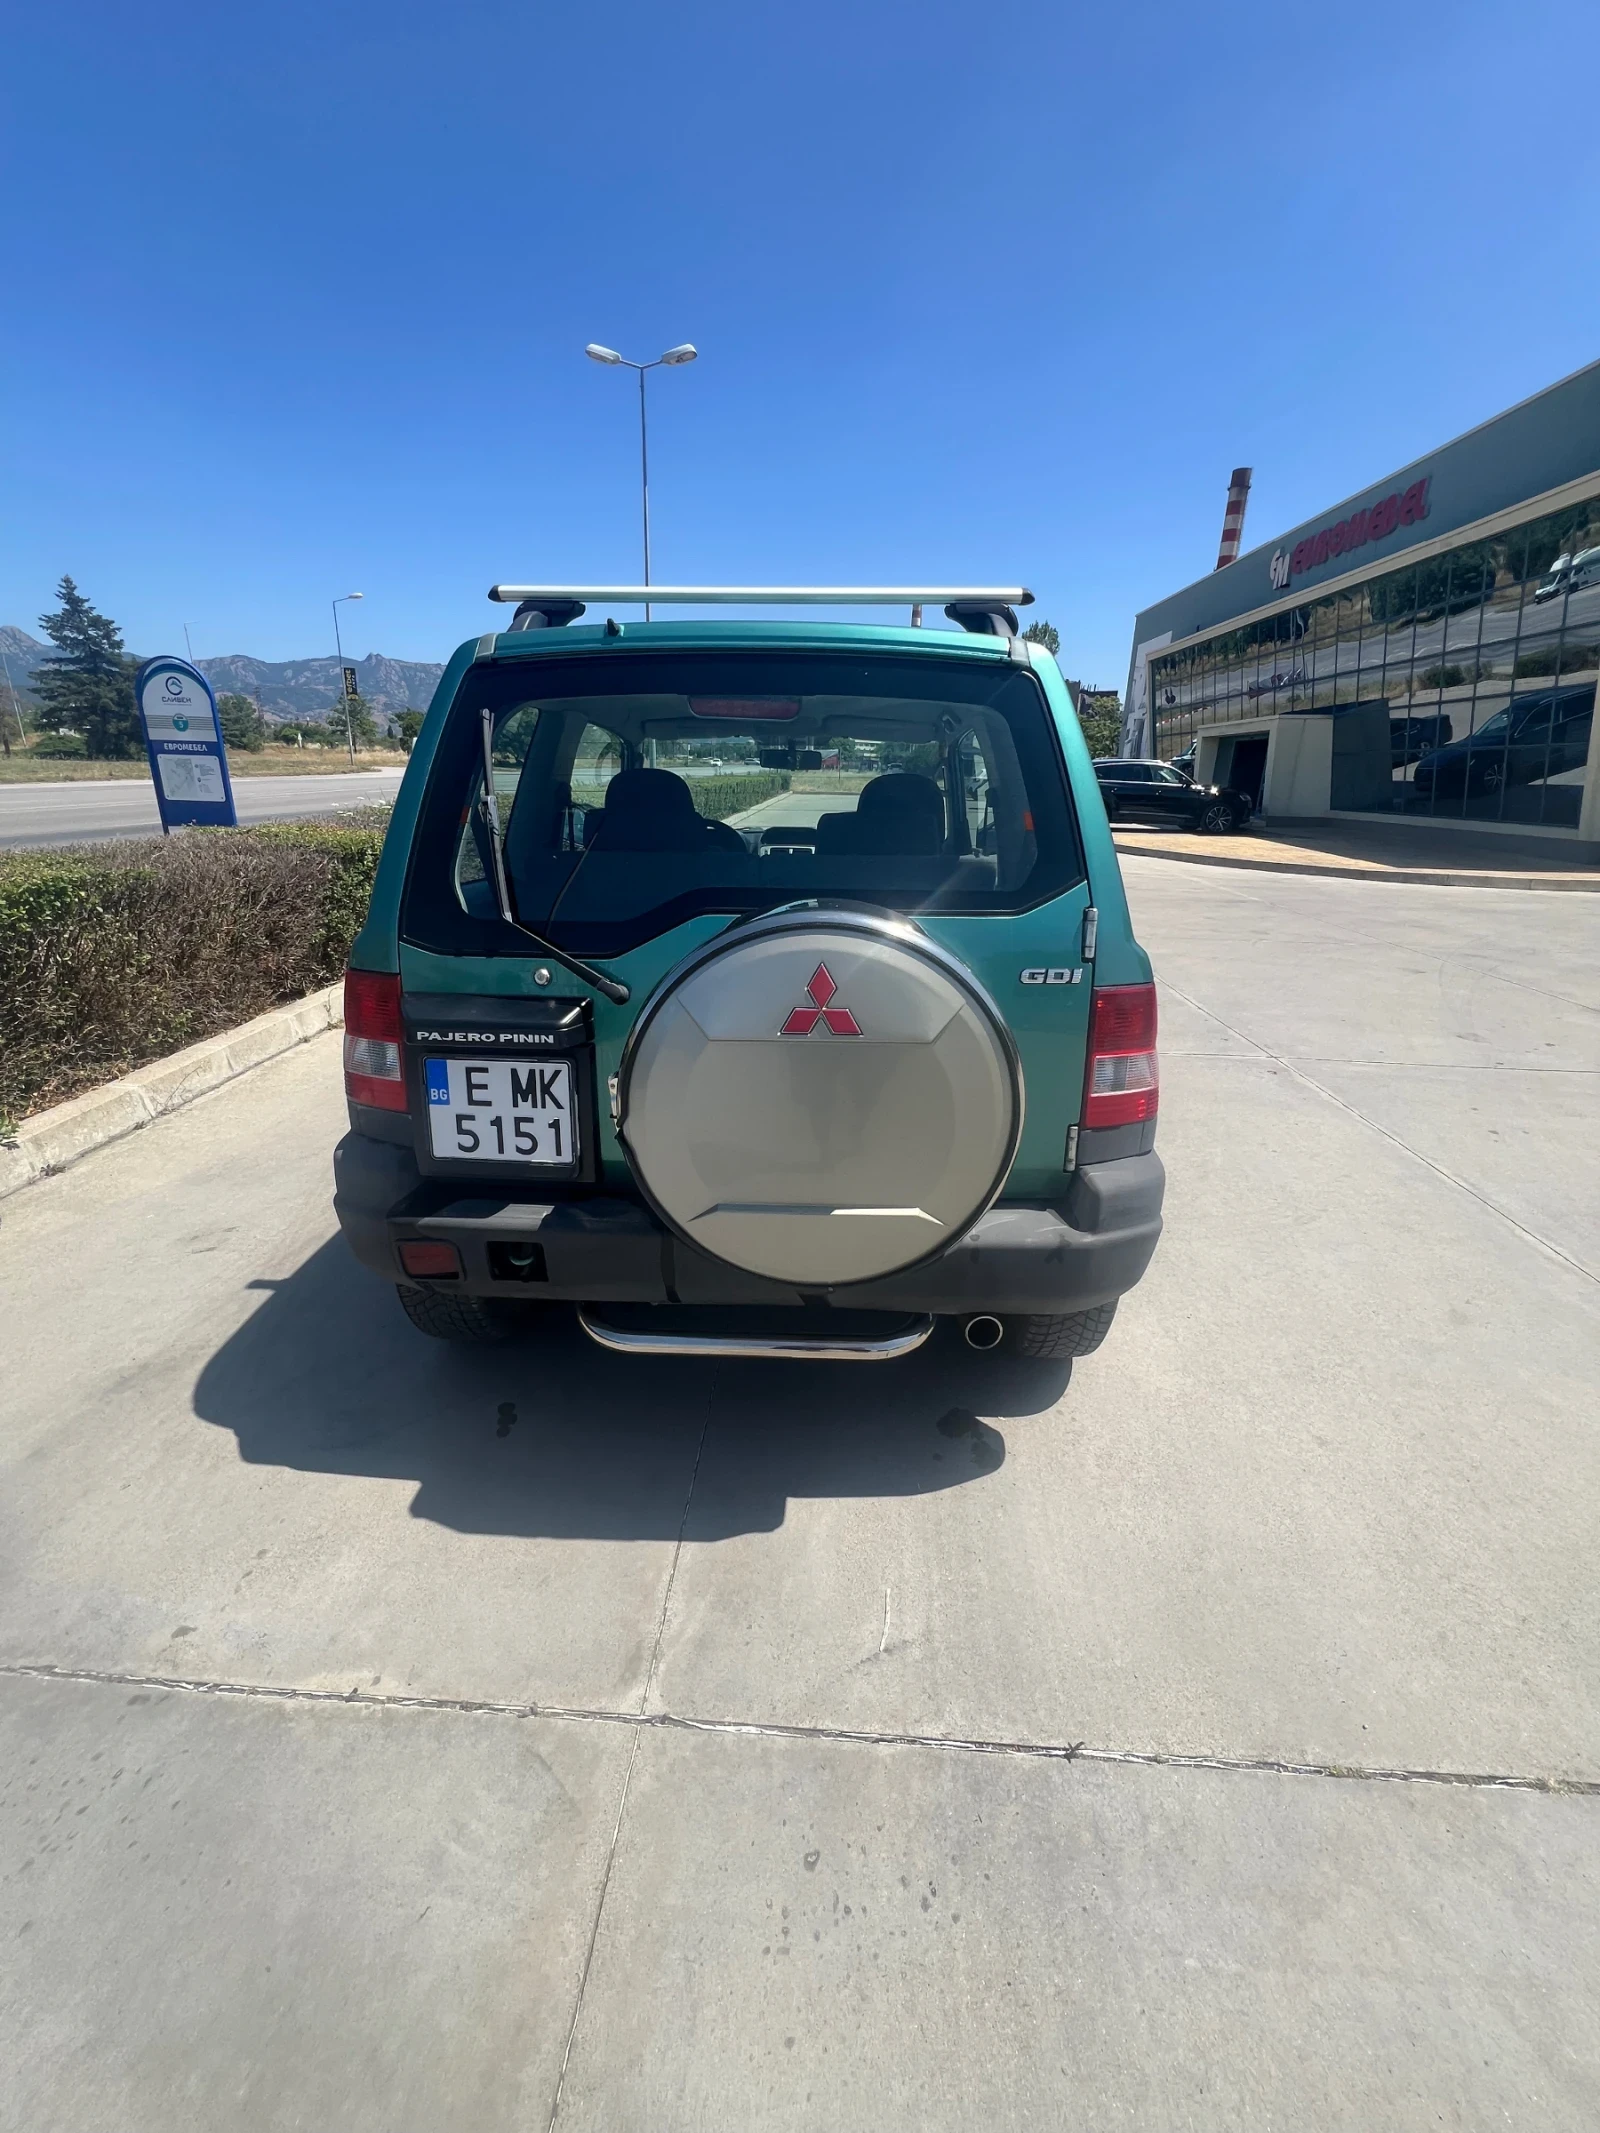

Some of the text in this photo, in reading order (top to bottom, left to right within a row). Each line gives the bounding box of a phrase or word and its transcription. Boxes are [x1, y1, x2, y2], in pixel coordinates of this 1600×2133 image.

[163, 742, 208, 752] ЕВРОМЕБЕЛ
[1020, 968, 1083, 984] GDI
[416, 1031, 555, 1044] PAJERO PININ
[430, 1088, 448, 1100] BG
[465, 1066, 565, 1110] E MK
[455, 1113, 563, 1157] 5151
